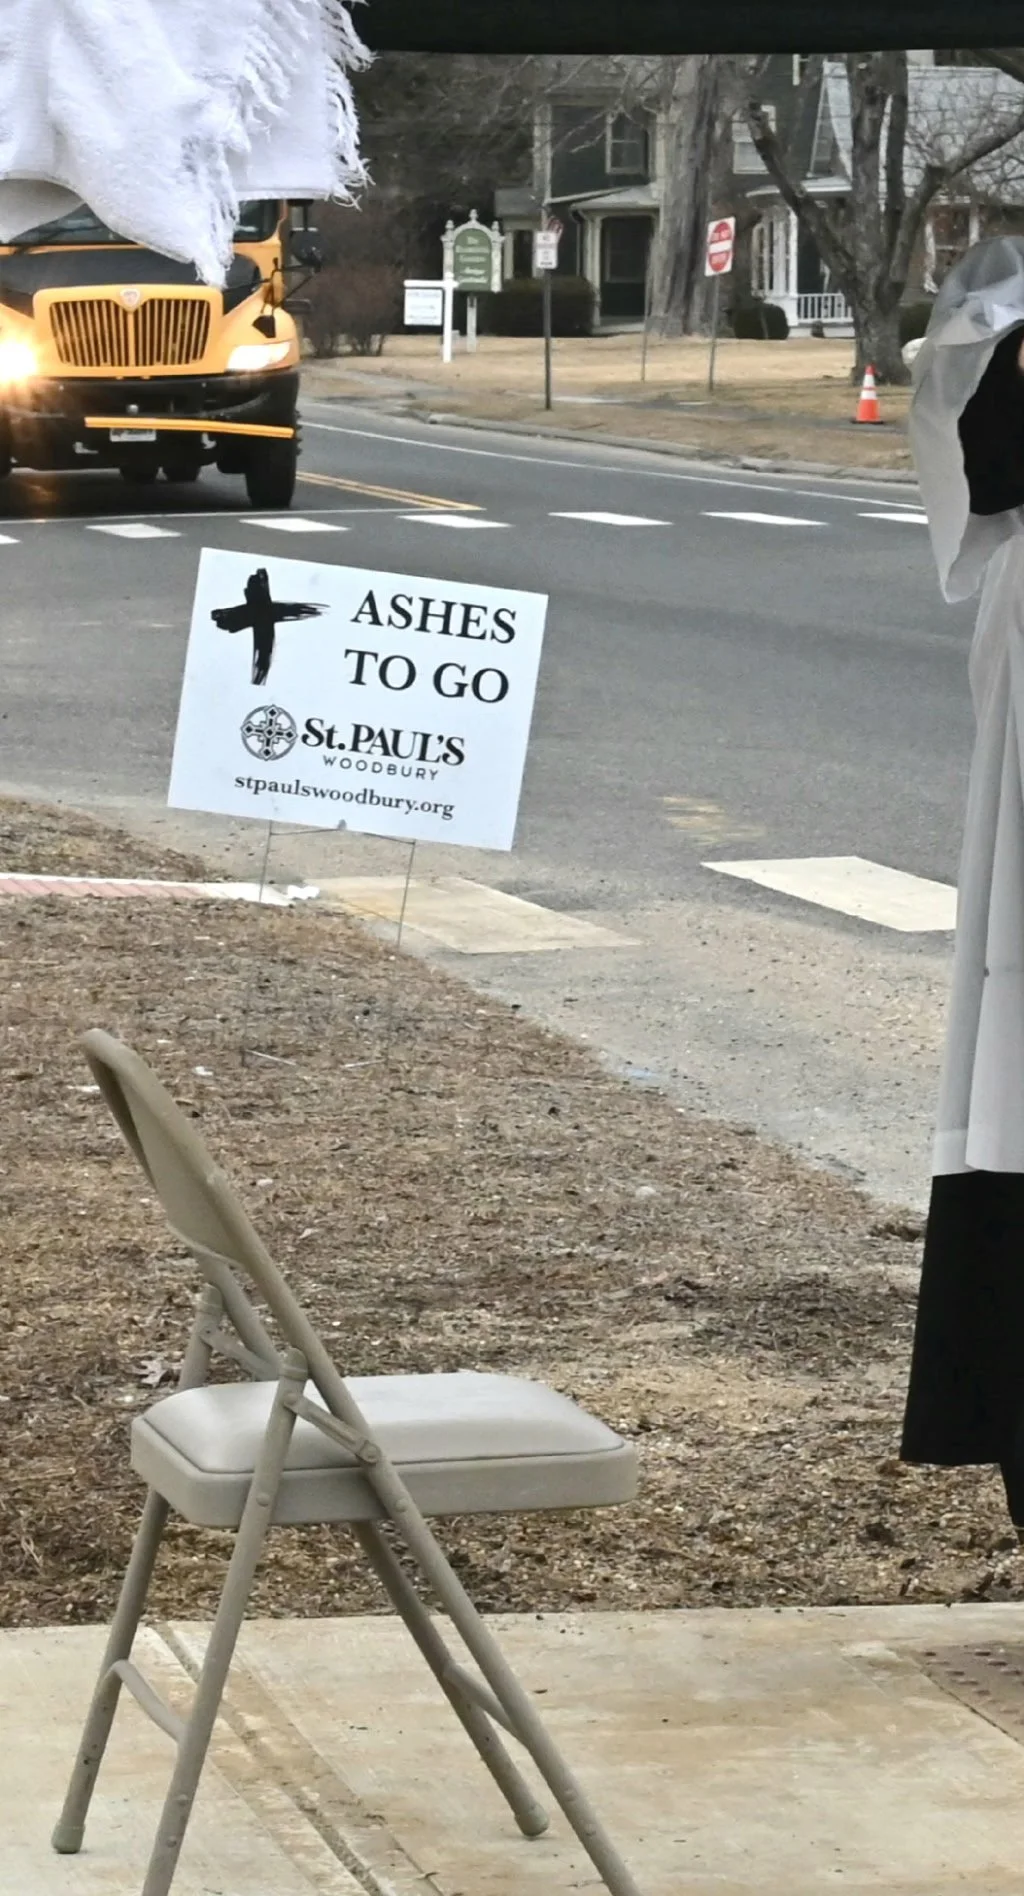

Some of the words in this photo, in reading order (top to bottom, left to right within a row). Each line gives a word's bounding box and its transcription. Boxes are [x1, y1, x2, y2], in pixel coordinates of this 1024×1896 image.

[350, 589, 516, 644] ASHES
[344, 648, 416, 691] TO
[432, 662, 509, 703] GO
[322, 755, 439, 781] WOODBURY
[234, 774, 455, 820] stpaulswoodbury.org
